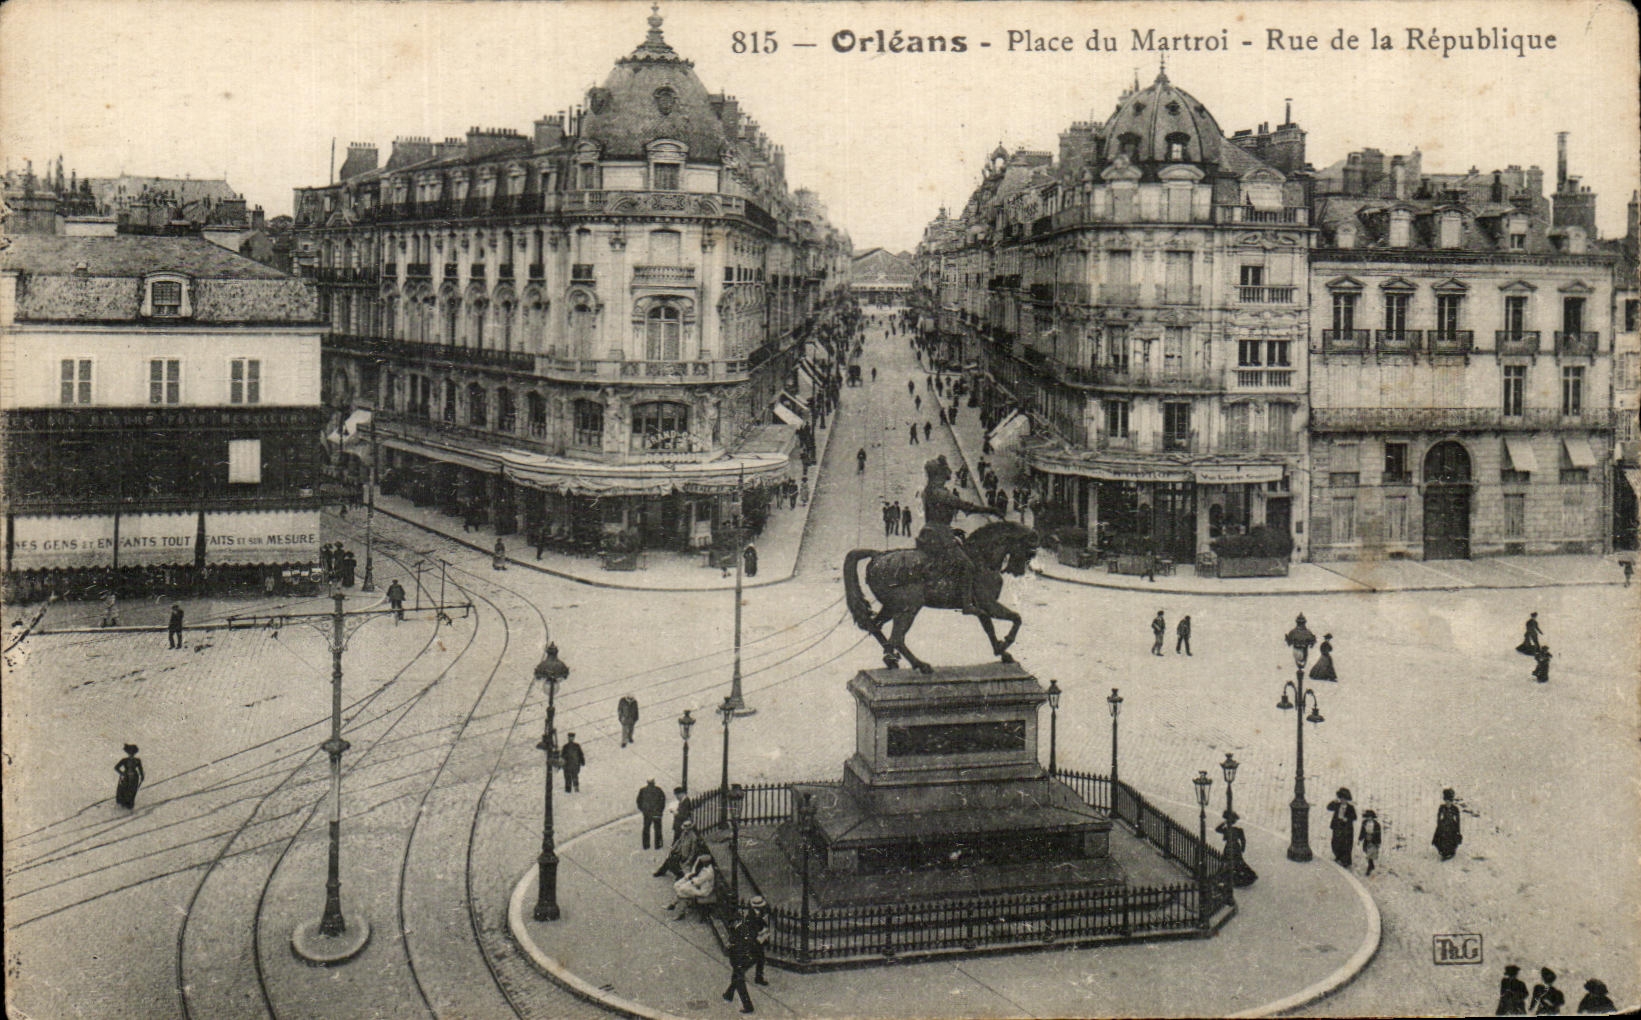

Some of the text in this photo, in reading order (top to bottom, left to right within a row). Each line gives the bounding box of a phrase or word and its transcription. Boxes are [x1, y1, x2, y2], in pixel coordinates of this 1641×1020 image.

[43, 538, 78, 551] GENS
[161, 535, 191, 547] TOUT
[266, 534, 316, 545] MESURE
